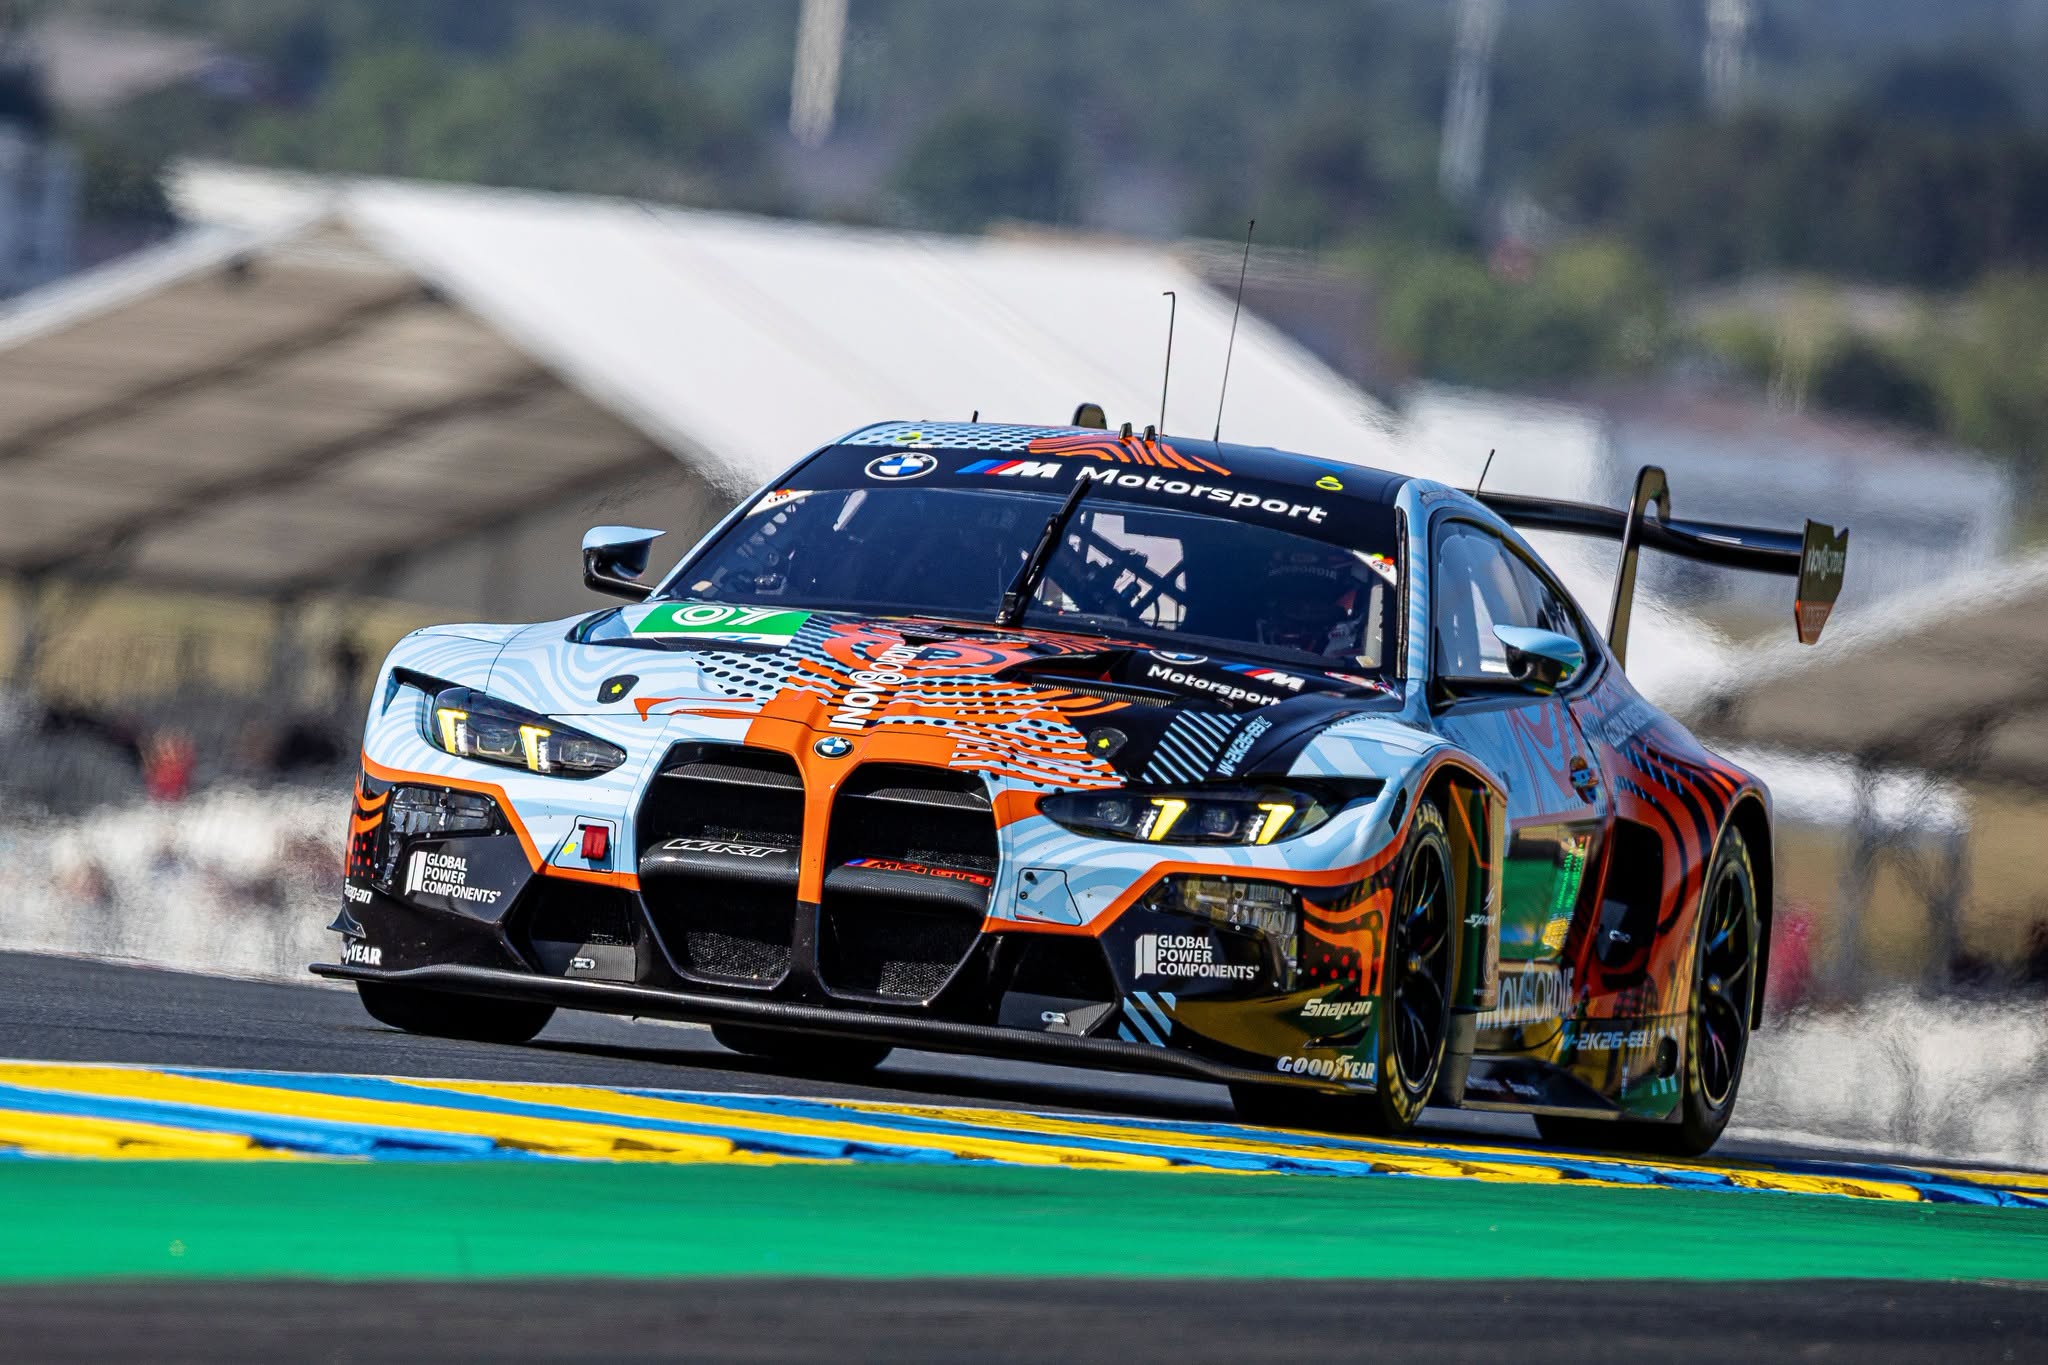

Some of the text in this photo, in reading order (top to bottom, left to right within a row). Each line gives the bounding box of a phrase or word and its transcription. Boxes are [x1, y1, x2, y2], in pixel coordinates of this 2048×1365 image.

[1076, 465, 1328, 524] Motorsport
[1147, 664, 1281, 706] Motorsport
[662, 838, 788, 858] WRT
[426, 853, 468, 872] GLOBAL
[424, 866, 466, 885] POWER
[1157, 934, 1213, 950] GLOBAL
[1157, 948, 1213, 964] POWER
[1300, 998, 1373, 1021] Snap-on
[1276, 1055, 1376, 1081] GOODYEAR
